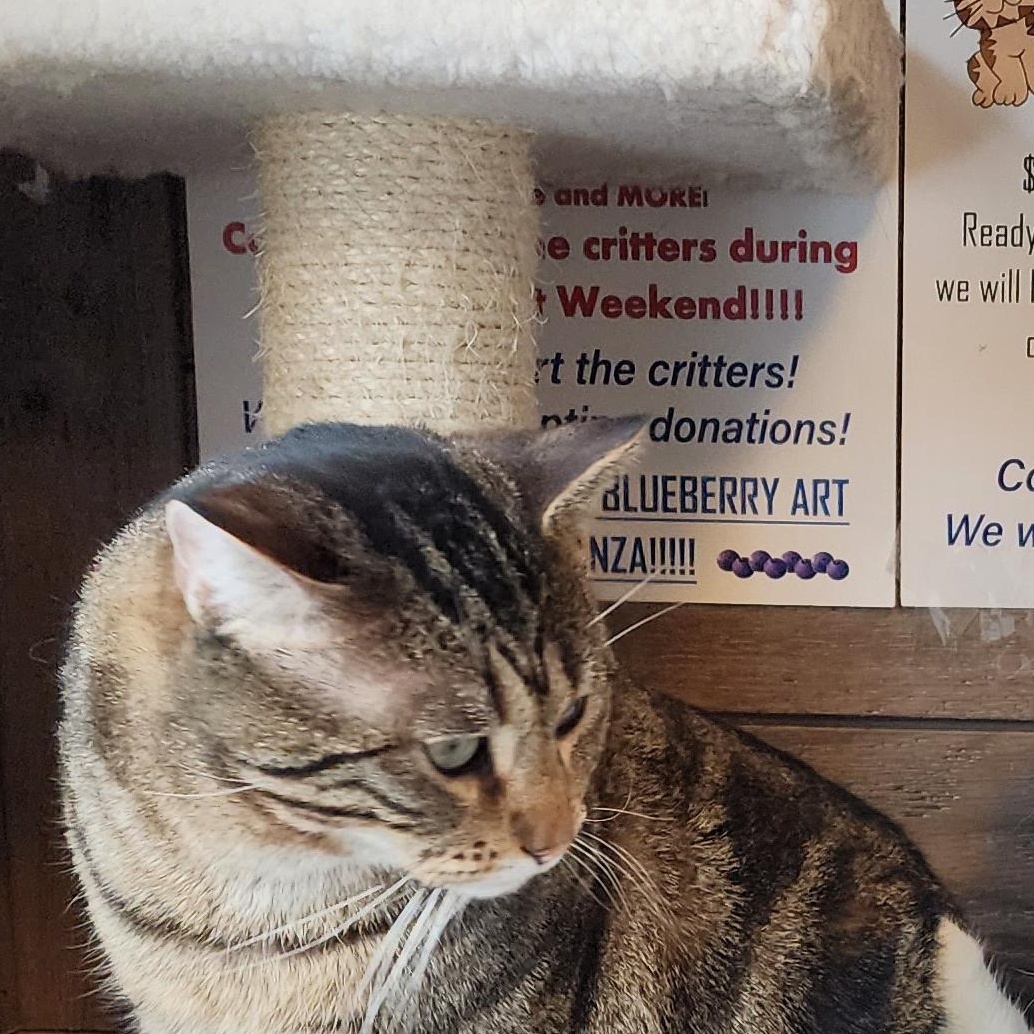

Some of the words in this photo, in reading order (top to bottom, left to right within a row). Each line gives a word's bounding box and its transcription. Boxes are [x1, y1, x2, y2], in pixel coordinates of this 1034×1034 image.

[552, 182, 609, 207] and
[582, 225, 718, 263] critters
[729, 226, 858, 275] during
[555, 283, 804, 322] Weekend!!!!
[935, 279, 970, 303] we
[979, 268, 1021, 304] will
[575, 348, 636, 386] the
[648, 350, 800, 389] critters!
[648, 406, 852, 446] donations!
[601, 473, 779, 516] BLUEBERRY
[790, 478, 850, 518] ART
[946, 513, 1004, 548] We
